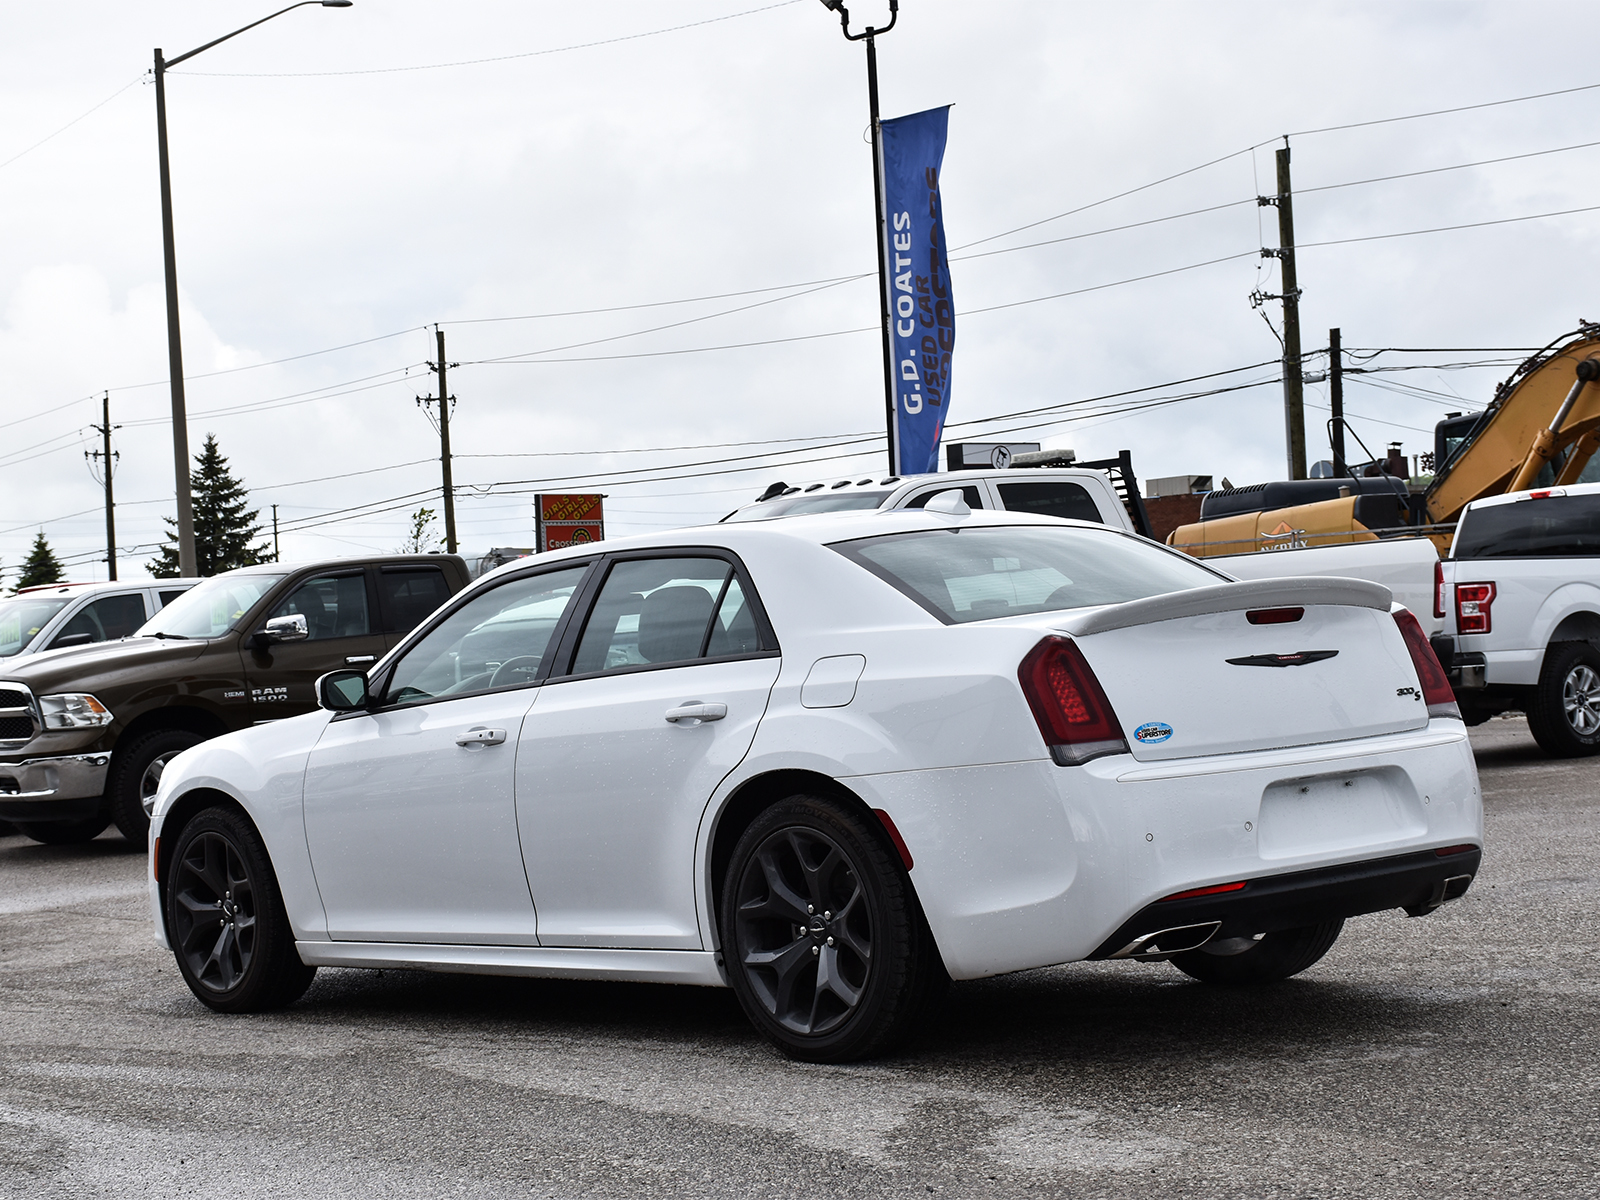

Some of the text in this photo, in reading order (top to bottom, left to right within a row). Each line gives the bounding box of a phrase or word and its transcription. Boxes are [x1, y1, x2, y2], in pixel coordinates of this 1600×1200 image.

[893, 211, 923, 415] G.D. COATES
[916, 274, 941, 407] USED CAR
[543, 495, 570, 520] GIRLS
[558, 495, 585, 520] GIRLS
[573, 495, 600, 520] GIRLS
[251, 687, 288, 696] RAM
[252, 694, 288, 703] 1500
[1137, 729, 1171, 740] SUPERSTORE
